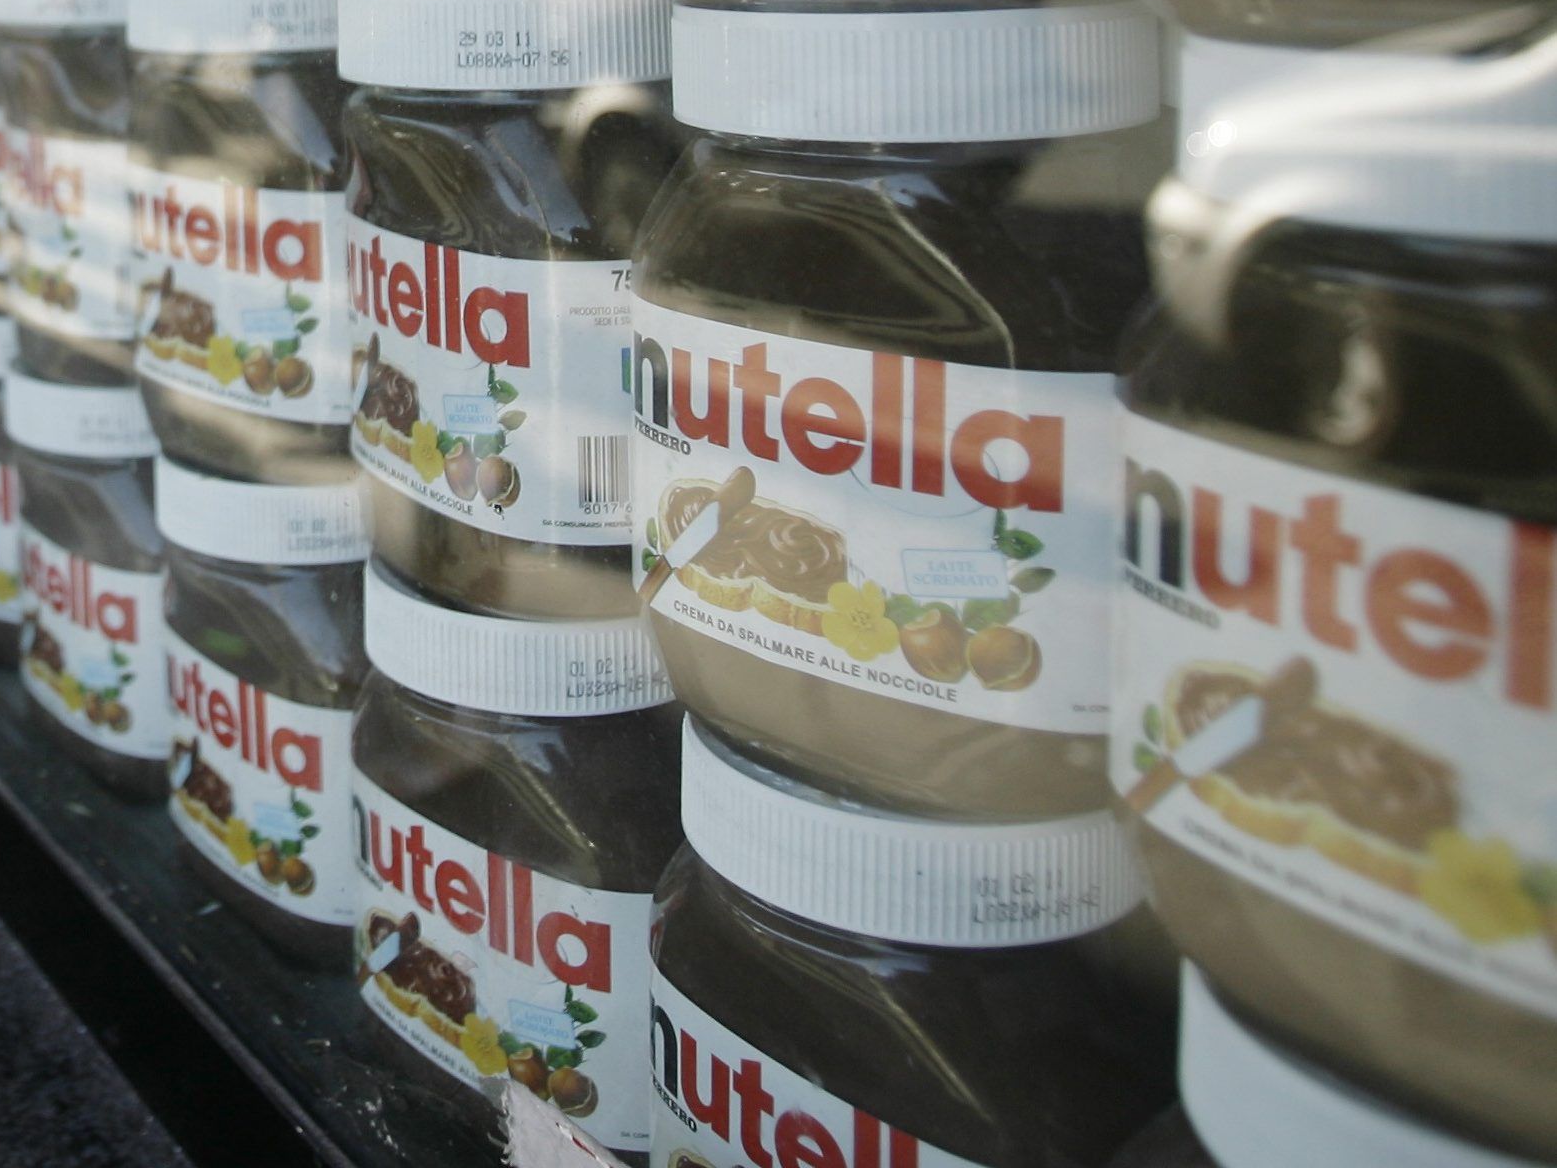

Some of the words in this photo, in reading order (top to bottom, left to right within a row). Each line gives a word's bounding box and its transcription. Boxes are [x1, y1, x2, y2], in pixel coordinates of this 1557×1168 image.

[458, 31, 478, 47] 29
[485, 31, 505, 48] 03
[515, 31, 531, 48] 11
[633, 329, 1065, 514] nutella
[928, 558, 978, 574] LATTE
[912, 571, 1000, 589] SCREMATO
[672, 598, 715, 628] CREMA
[716, 615, 736, 637] DA
[738, 626, 816, 665] SPALMARE
[818, 653, 862, 678] ALLE
[866, 667, 959, 703] NOCCIOLE
